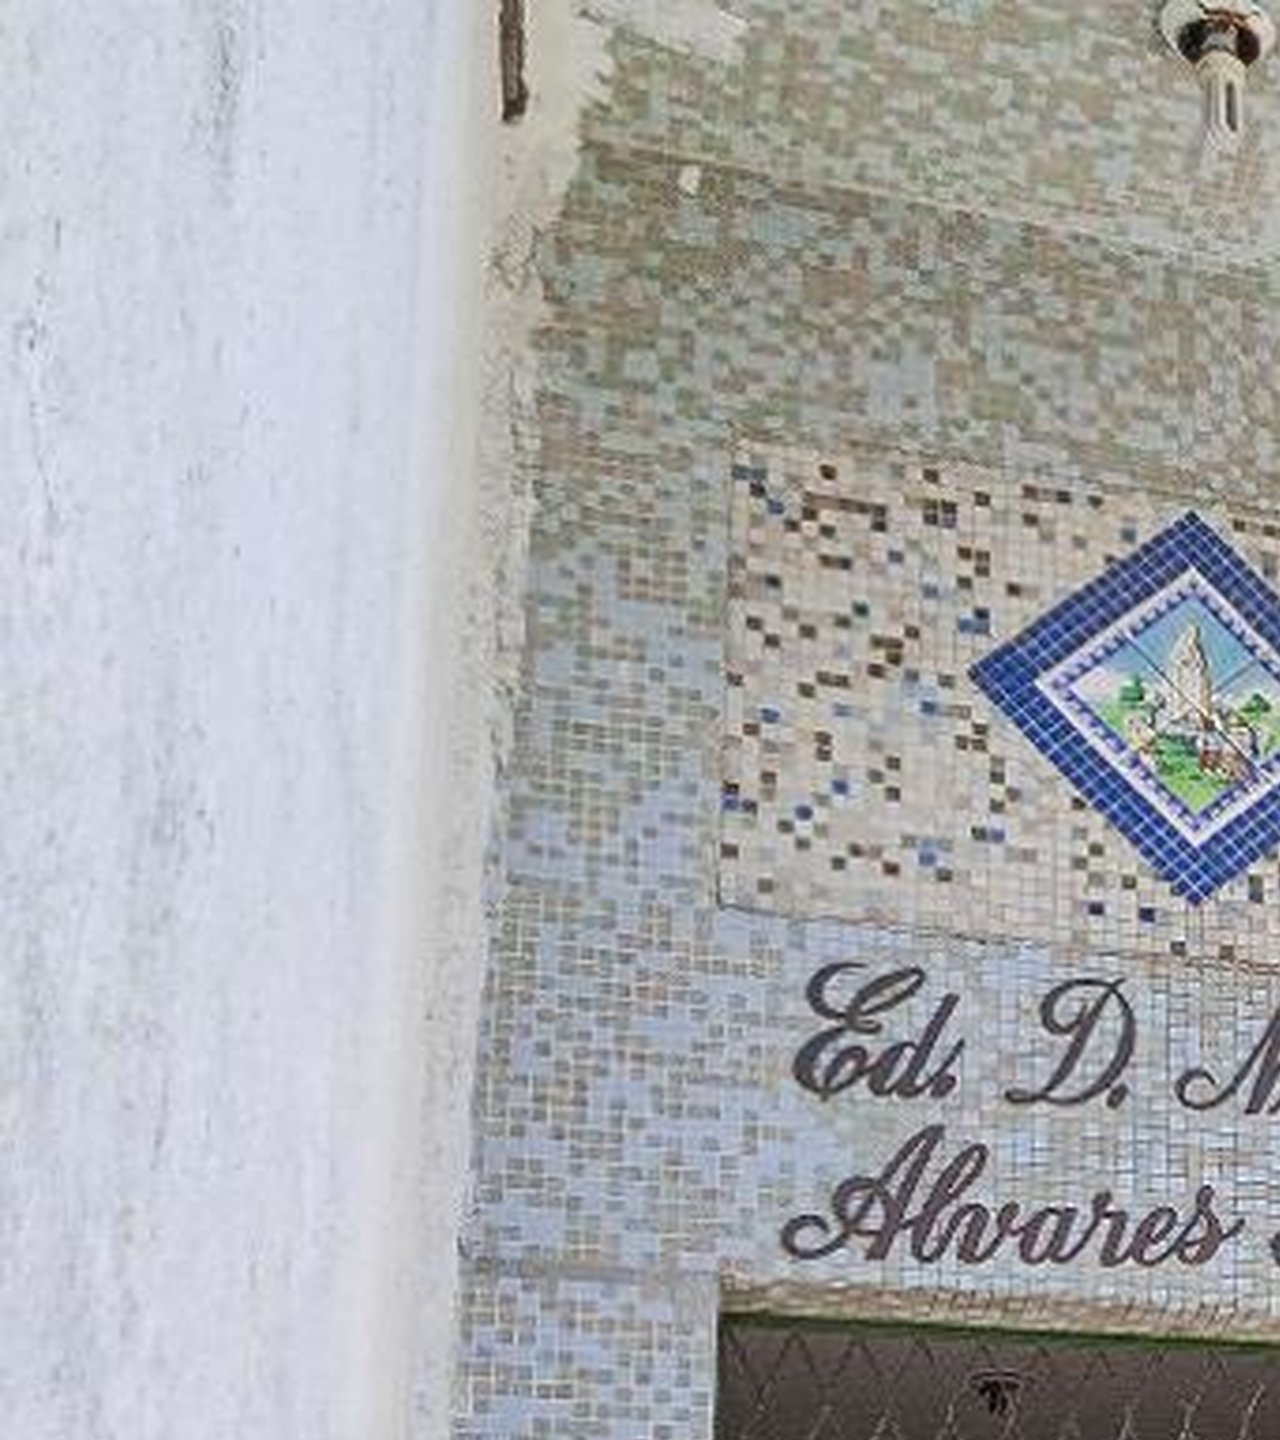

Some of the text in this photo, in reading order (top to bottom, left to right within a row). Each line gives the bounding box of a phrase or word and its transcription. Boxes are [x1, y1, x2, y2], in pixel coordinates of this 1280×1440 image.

[792, 961, 966, 1101] Ed.
[1004, 977, 1137, 1110] D.
[781, 1123, 1247, 1268] Alvares
